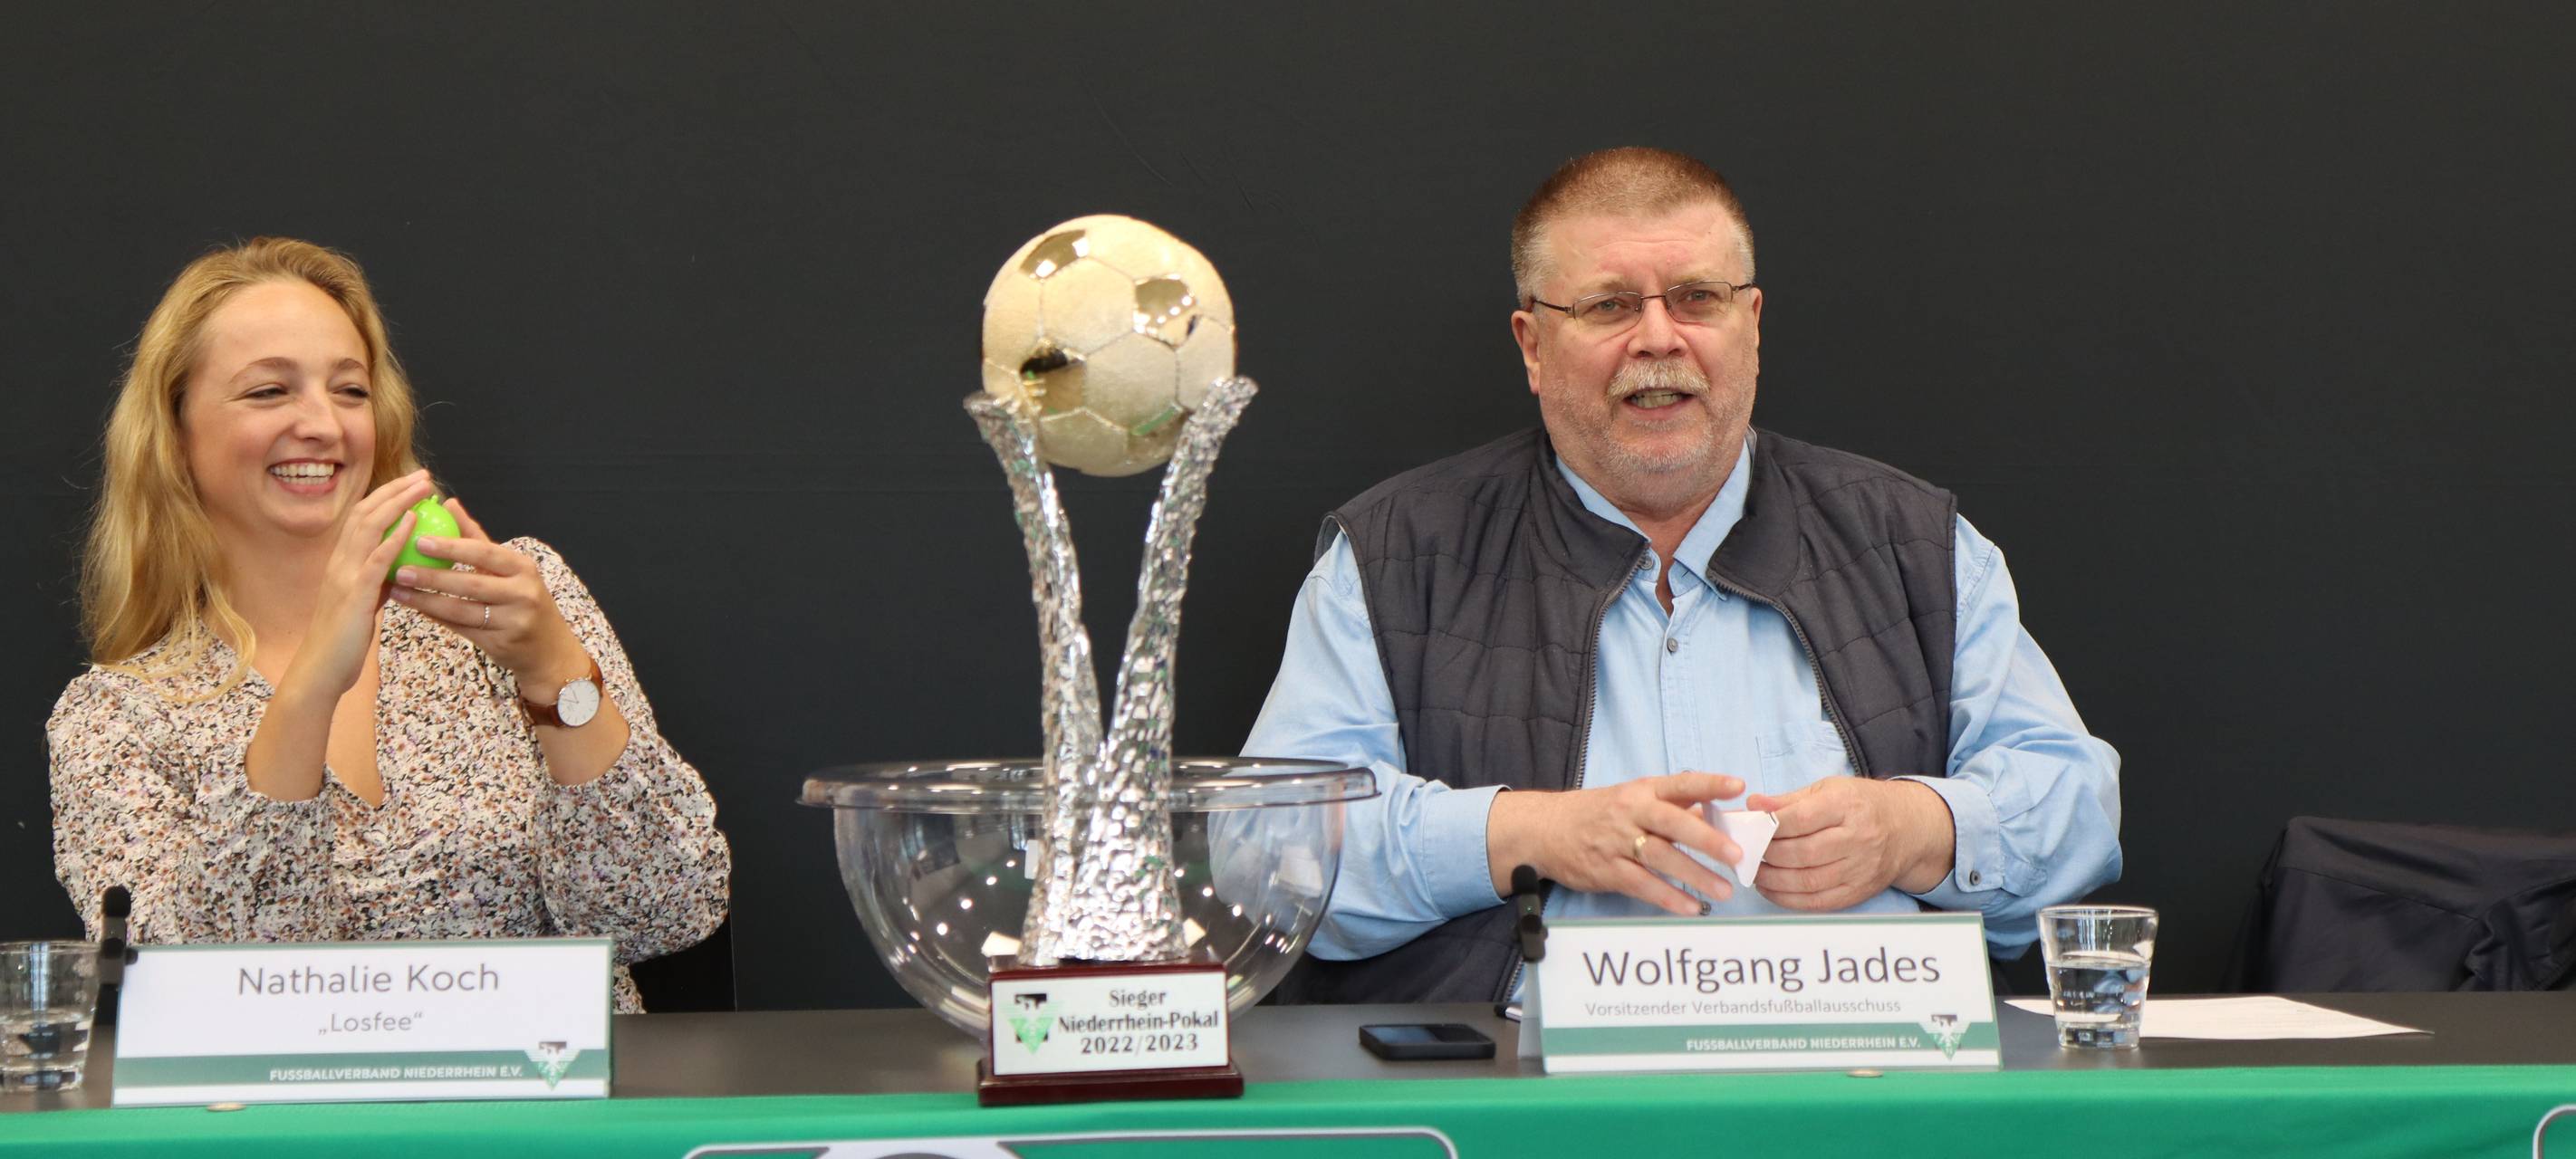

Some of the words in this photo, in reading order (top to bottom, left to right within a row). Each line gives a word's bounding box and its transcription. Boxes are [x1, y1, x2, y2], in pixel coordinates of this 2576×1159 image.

[238, 965, 392, 995] Nathalie
[408, 963, 499, 992] Koch
[1582, 948, 1804, 994] Wolfgang
[1817, 946, 1941, 985] Jades
[1109, 990, 1167, 1010] Sieger
[1585, 1001, 1687, 1017] Vorsitzender
[1693, 999, 1901, 1016] Verbandsfußballausschuss
[1059, 1011, 1218, 1032] Niederrhein-Pokal
[1081, 1033, 1198, 1056] 2022/2023
[1687, 1038, 1807, 1051] FUSSBALLVERBAND
[1811, 1037, 1896, 1050] NIEDERRHEIN
[1899, 1037, 1920, 1049] E.V.
[269, 1067, 400, 1082] FUSSBALLVERBAND
[403, 1066, 498, 1080] NIEDERRHEIN
[500, 1066, 523, 1078] E.V.
